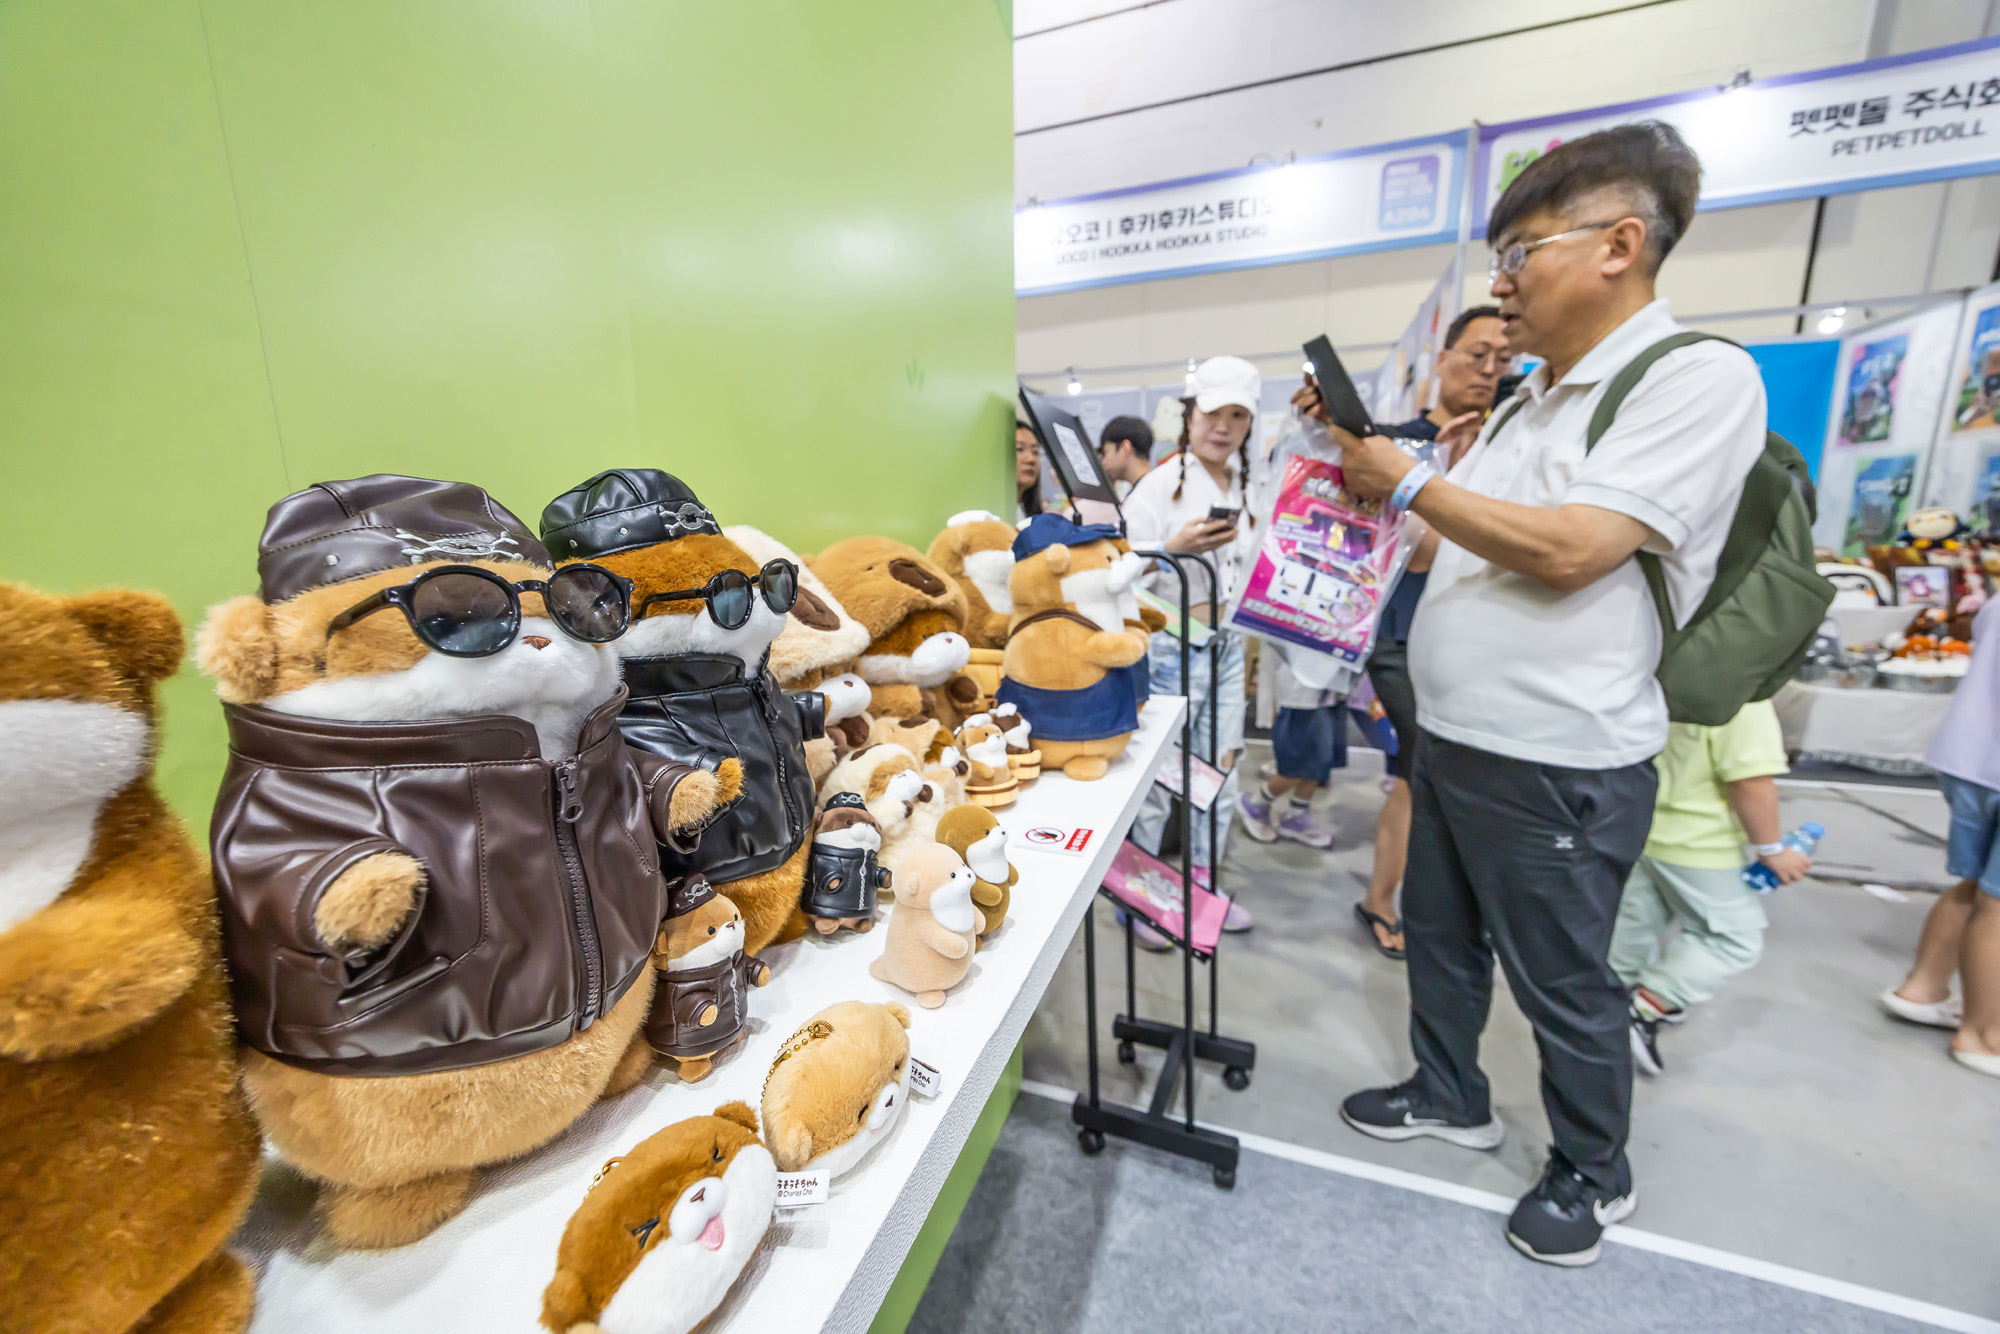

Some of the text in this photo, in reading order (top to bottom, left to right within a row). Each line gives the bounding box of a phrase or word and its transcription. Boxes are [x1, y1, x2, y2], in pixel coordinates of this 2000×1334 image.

[1791, 96, 1889, 137] 펫펫돌
[1831, 119, 1987, 157] PETPETDOLL
[1100, 241, 1152, 259] HOOKKA
[1156, 231, 1212, 251] HOOKKA
[1216, 223, 1269, 243] STUDIO
